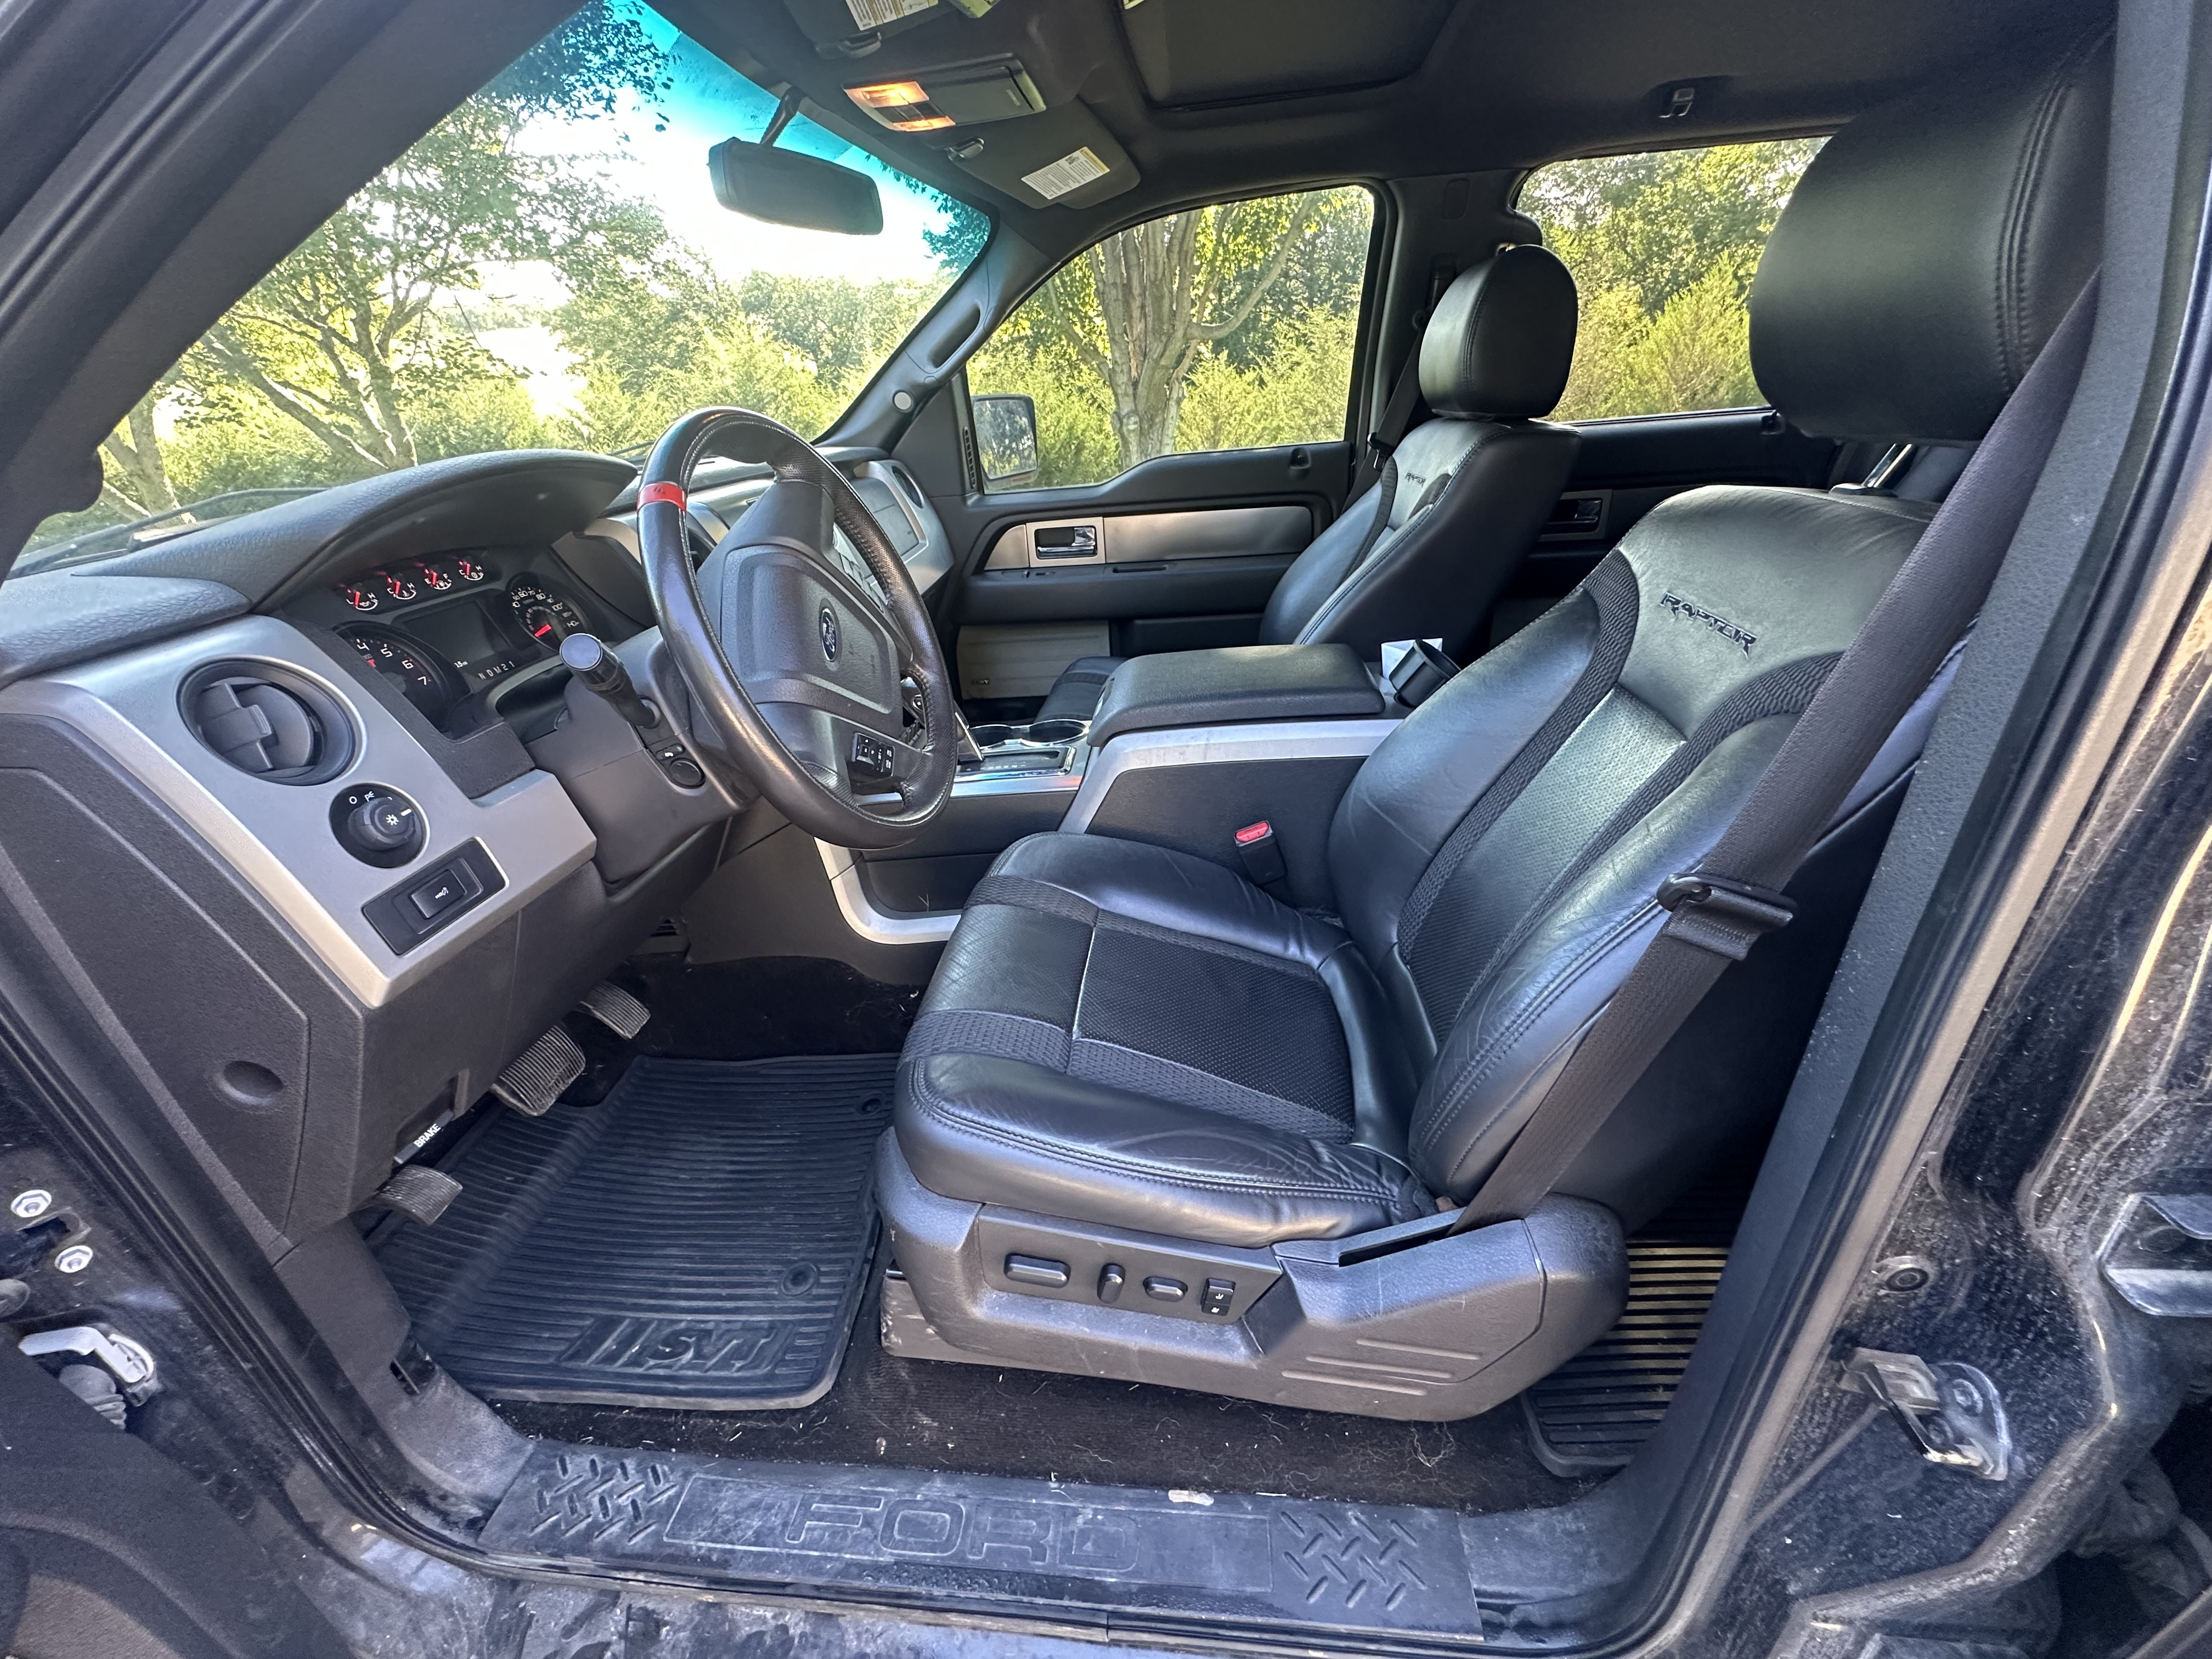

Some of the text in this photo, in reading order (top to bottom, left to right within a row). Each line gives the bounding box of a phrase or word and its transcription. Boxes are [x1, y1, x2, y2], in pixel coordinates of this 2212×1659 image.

[1660, 591, 1757, 659] RAPTOR
[357, 642, 370, 651] 4
[380, 647, 393, 658] 5
[402, 659, 414, 669] 6
[417, 676, 427, 686] 7
[413, 1123, 441, 1148] BRAKE
[785, 1492, 1140, 1572] FORD
